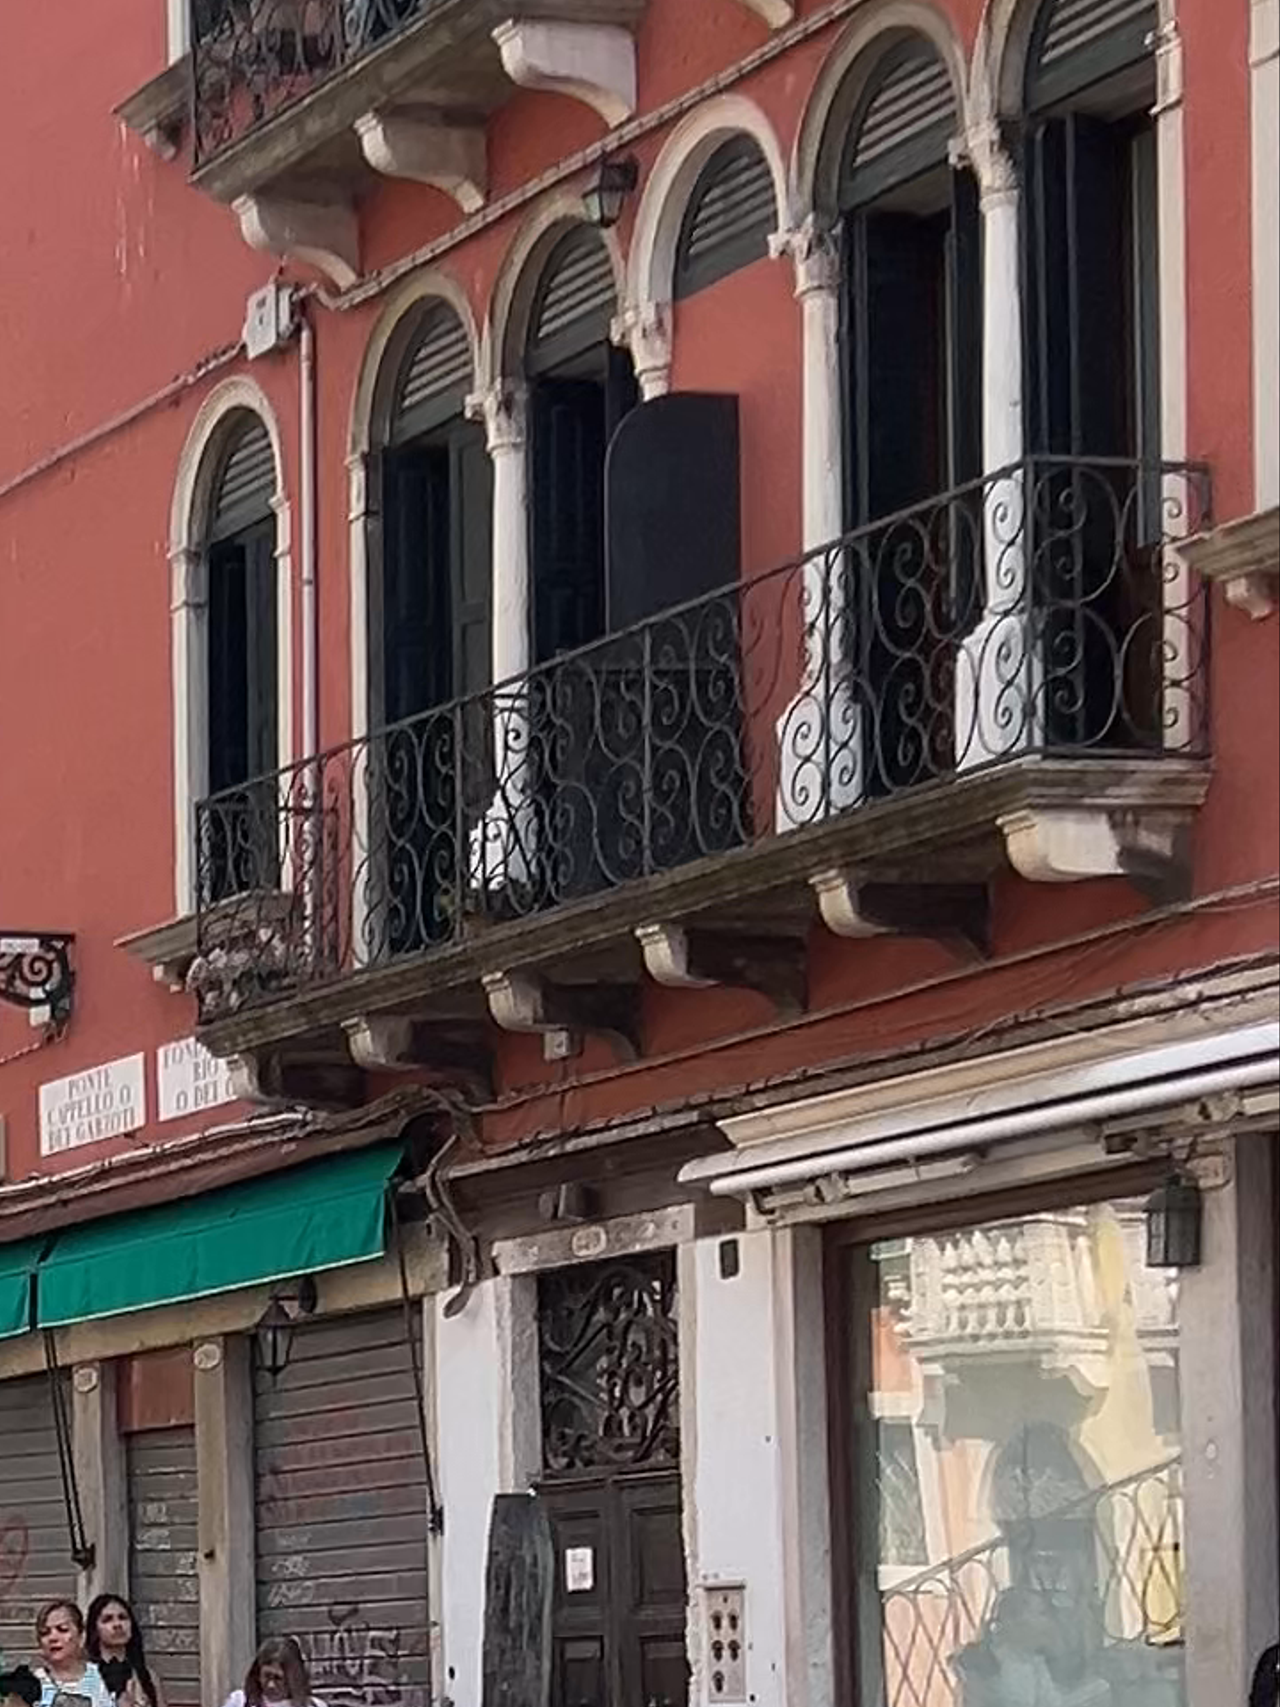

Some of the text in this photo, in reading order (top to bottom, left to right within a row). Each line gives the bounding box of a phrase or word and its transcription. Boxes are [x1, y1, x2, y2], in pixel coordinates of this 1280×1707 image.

[193, 1050, 219, 1083] RIO
[68, 1067, 111, 1101] PONTE
[176, 1090, 188, 1111] O
[47, 1084, 132, 1127] CAPPELLO O
